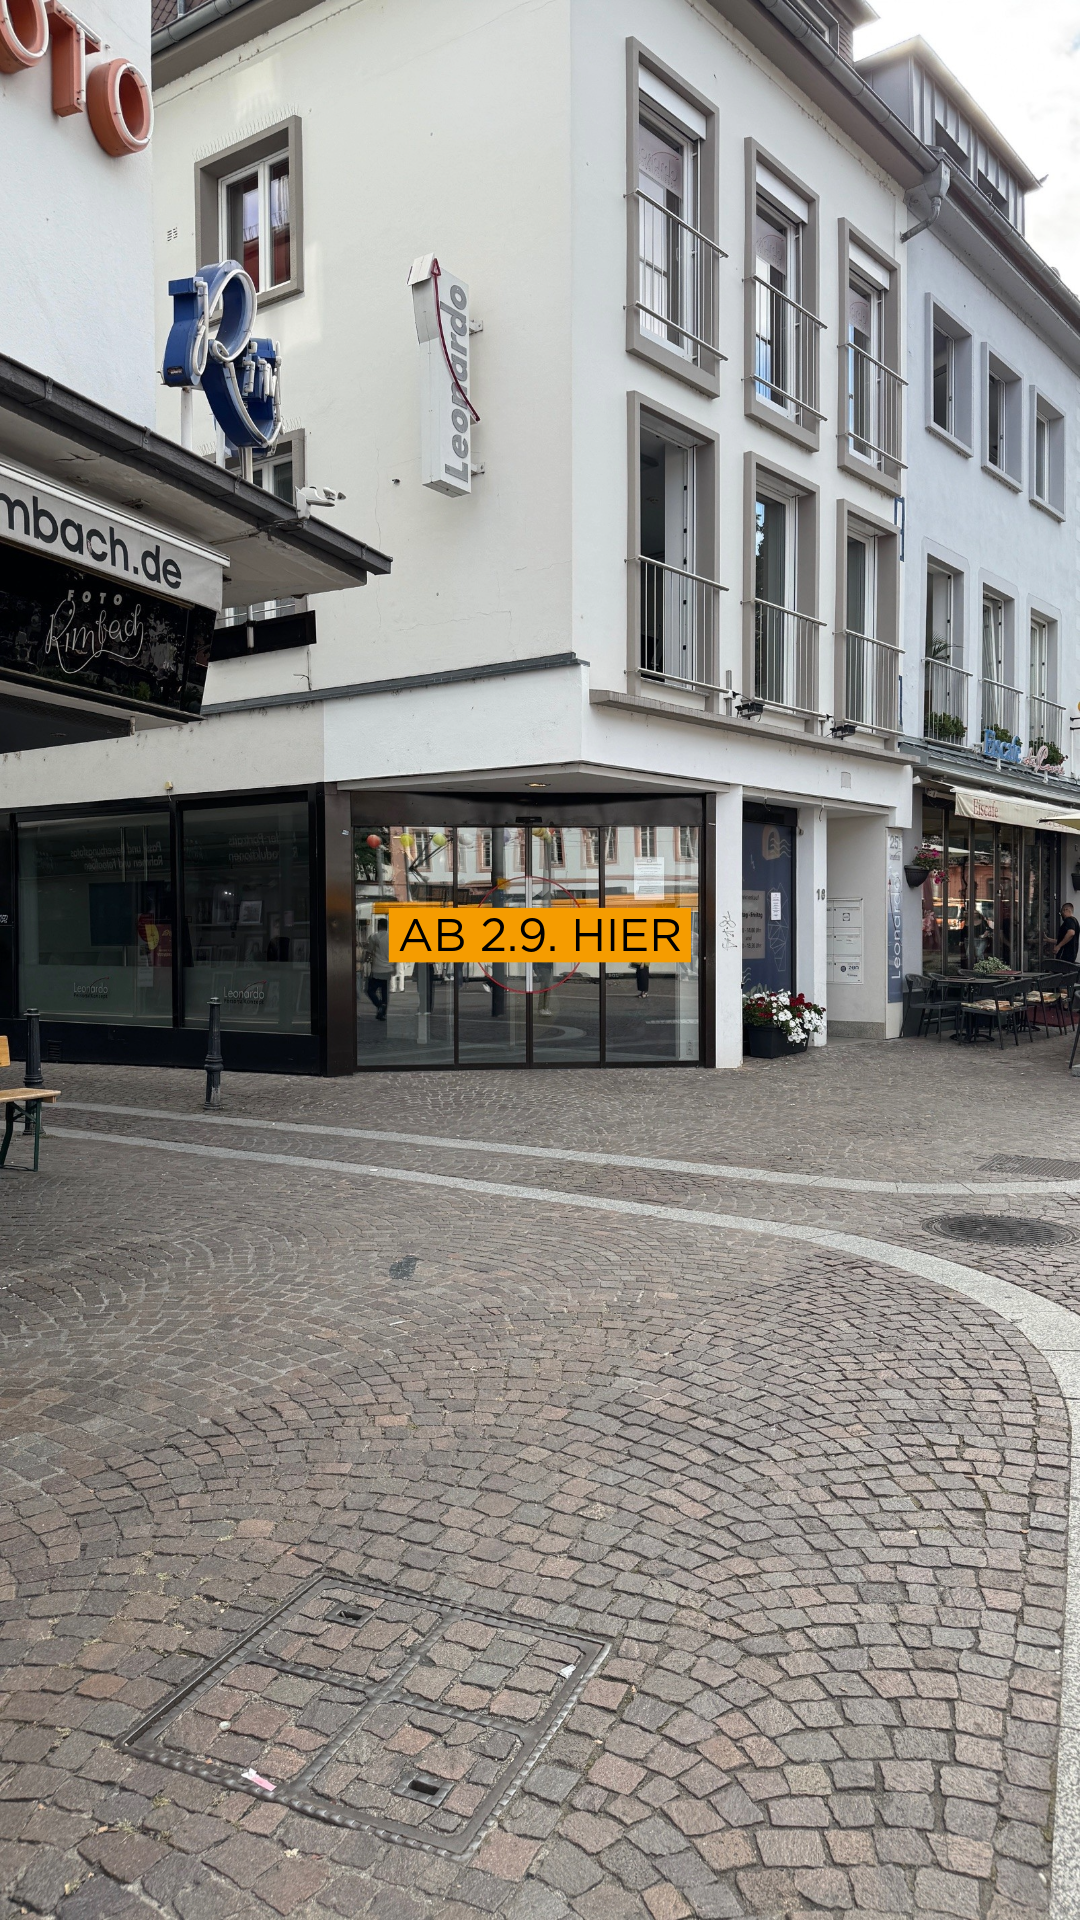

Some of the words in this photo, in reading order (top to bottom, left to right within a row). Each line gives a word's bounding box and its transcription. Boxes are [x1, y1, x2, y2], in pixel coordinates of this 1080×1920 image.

[440, 284, 469, 484] Leonardo
[67, 589, 123, 606] FOTO
[816, 888, 826, 901] 18
[73, 982, 108, 994] Leonardo
[223, 986, 265, 999] Leonardo
